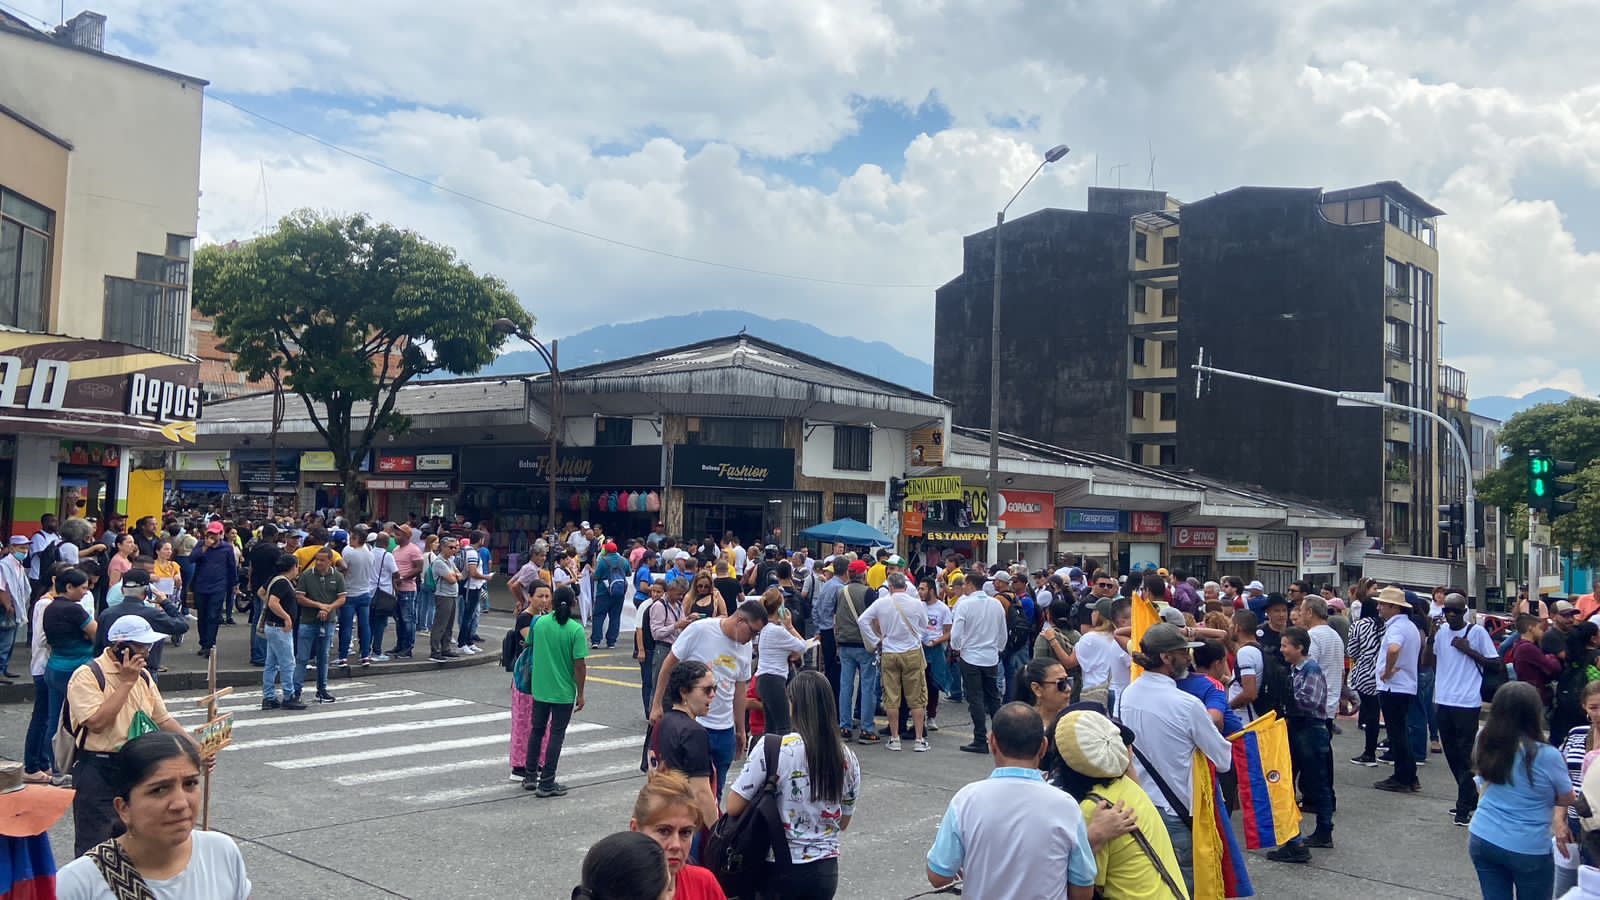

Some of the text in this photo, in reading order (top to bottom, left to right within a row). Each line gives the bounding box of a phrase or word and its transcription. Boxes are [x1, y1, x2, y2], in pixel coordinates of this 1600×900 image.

[719, 463, 769, 478] Fashion
[1532, 459, 1548, 473] 31
[928, 531, 1004, 542] ESTAMPADS
